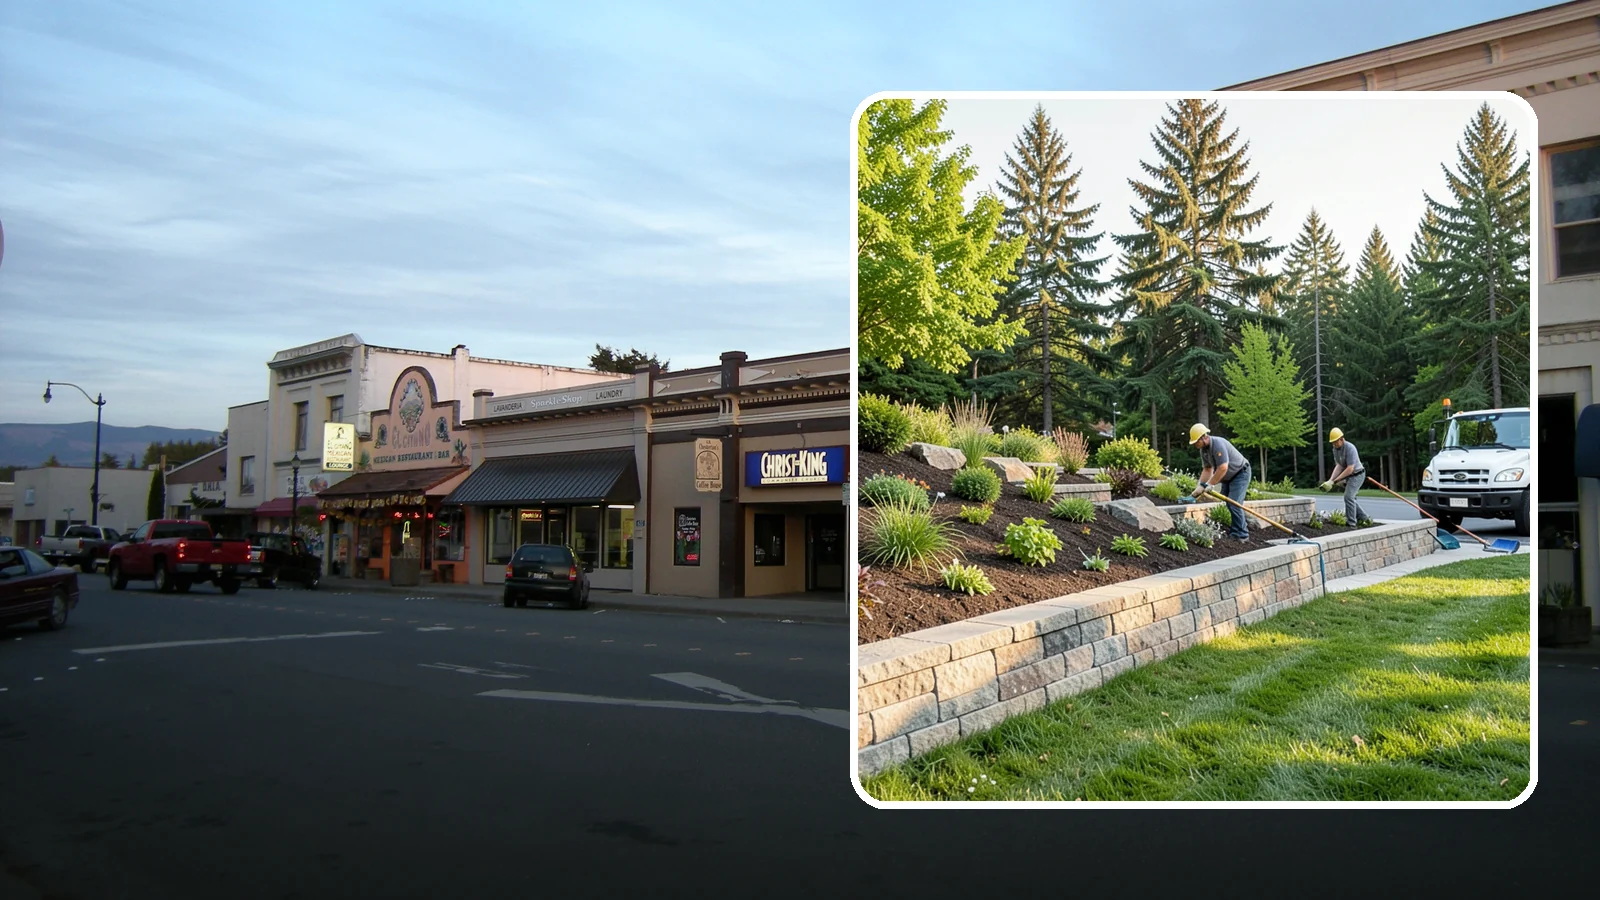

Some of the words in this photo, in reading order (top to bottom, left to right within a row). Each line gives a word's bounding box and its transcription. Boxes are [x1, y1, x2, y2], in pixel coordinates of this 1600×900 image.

[493, 402, 522, 412] LAVANDERIA
[562, 394, 583, 405] Shop
[595, 389, 624, 400] LAUNDRY
[373, 455, 396, 464] MEXICAN
[397, 451, 434, 462] RESTAURANT
[437, 450, 450, 459] BAR
[761, 452, 798, 478] CHRIST
[799, 450, 828, 477] KING
